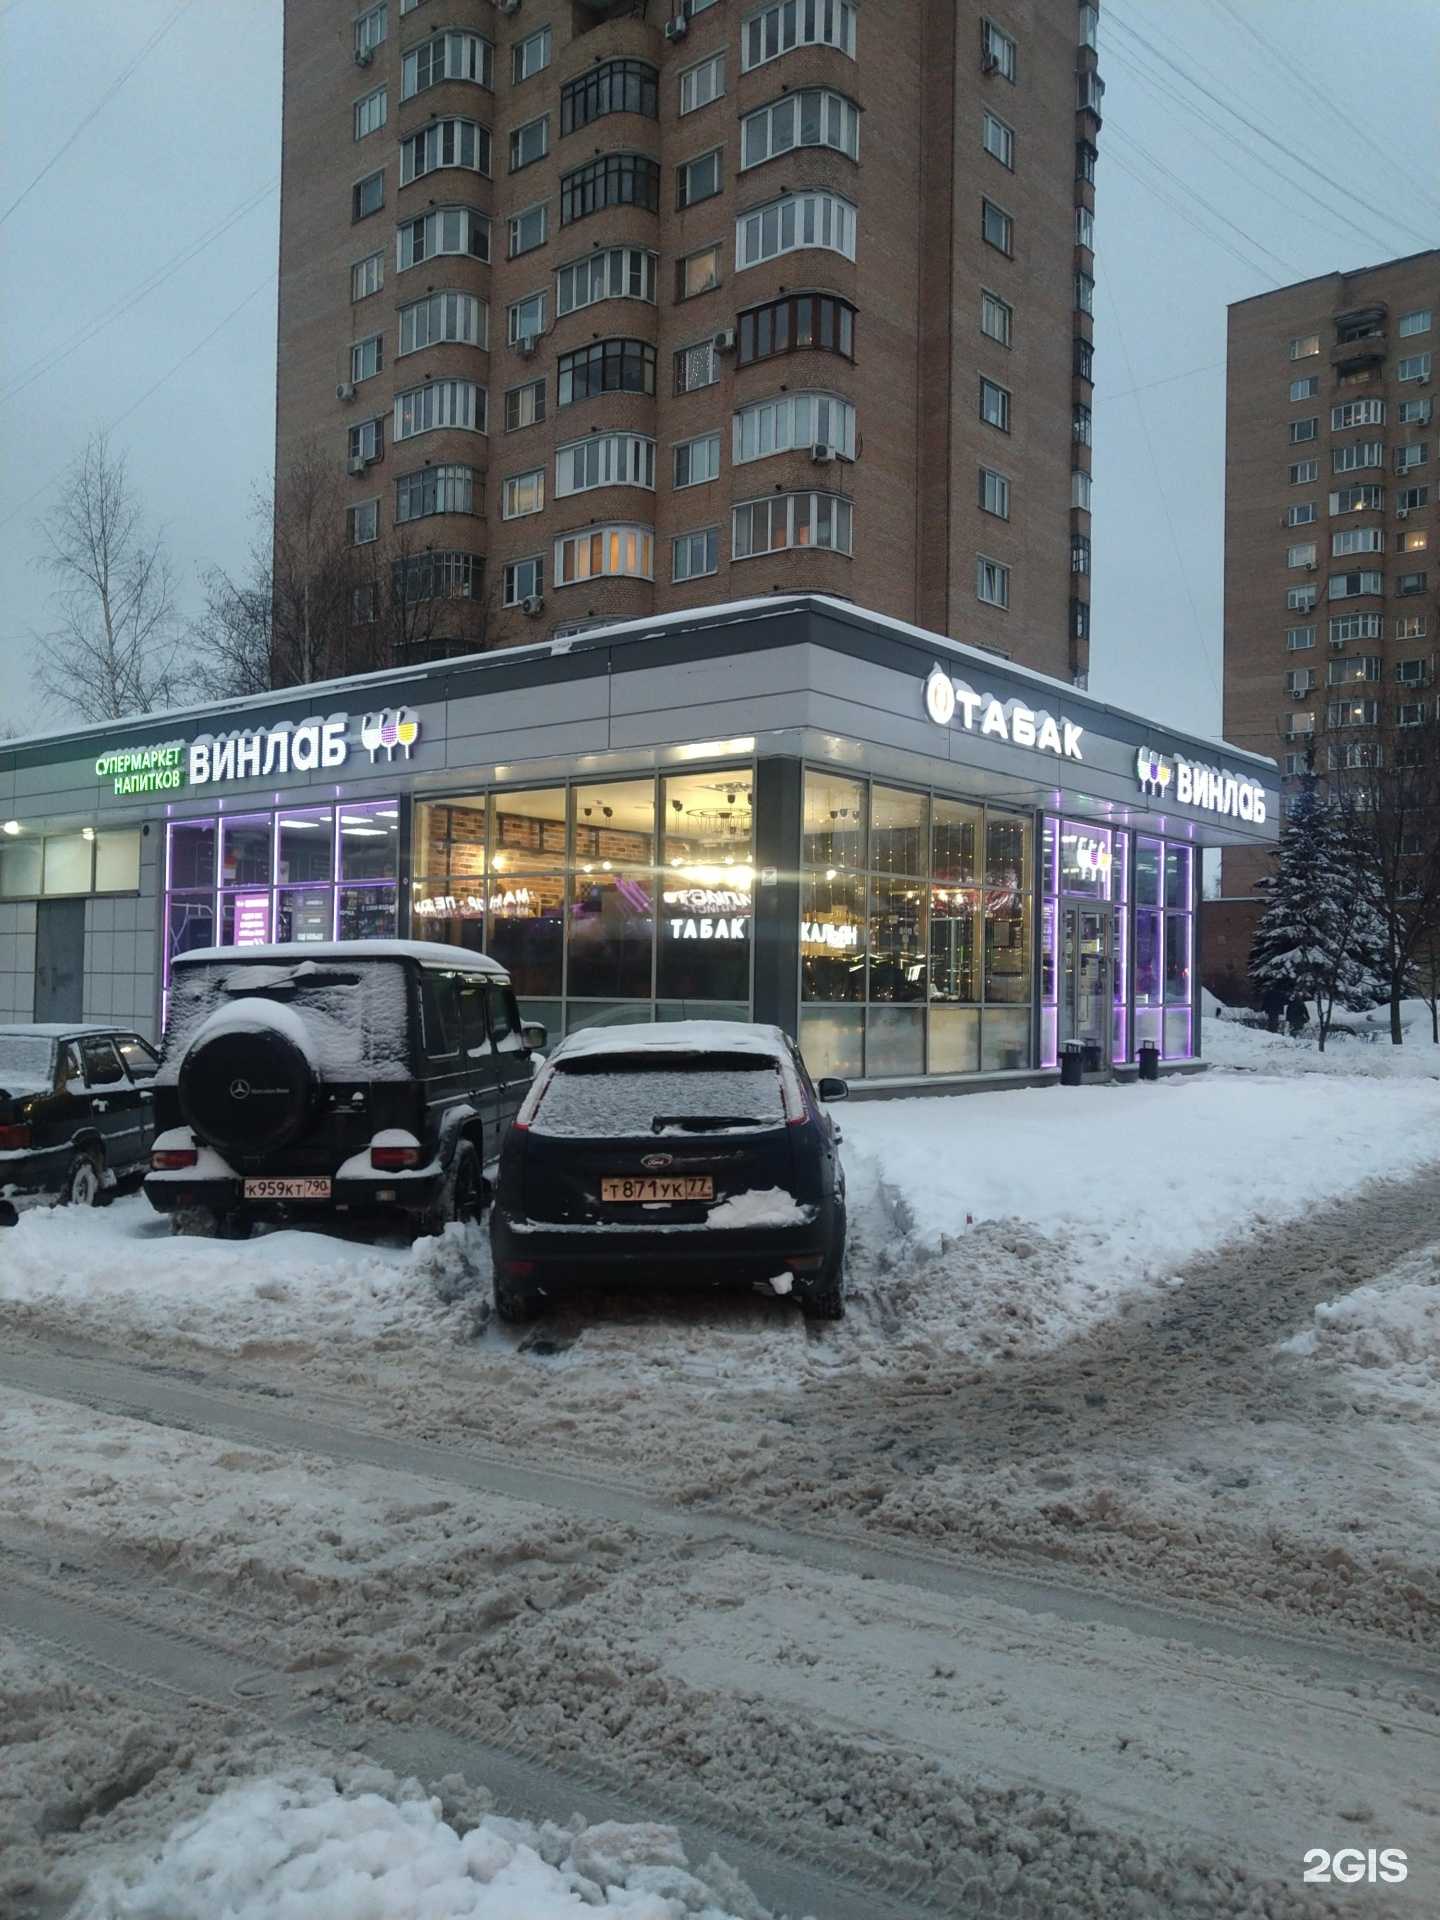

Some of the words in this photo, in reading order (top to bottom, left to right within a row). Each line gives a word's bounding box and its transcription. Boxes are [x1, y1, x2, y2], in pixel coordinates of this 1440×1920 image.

[96, 747, 181, 776] СУПЕРМАРКЕТ
[114, 770, 180, 795] НАПИТКОВ
[670, 918, 745, 939] ТАБАК
[305, 1180, 327, 1192] 790
[688, 1178, 706, 1192] 77
